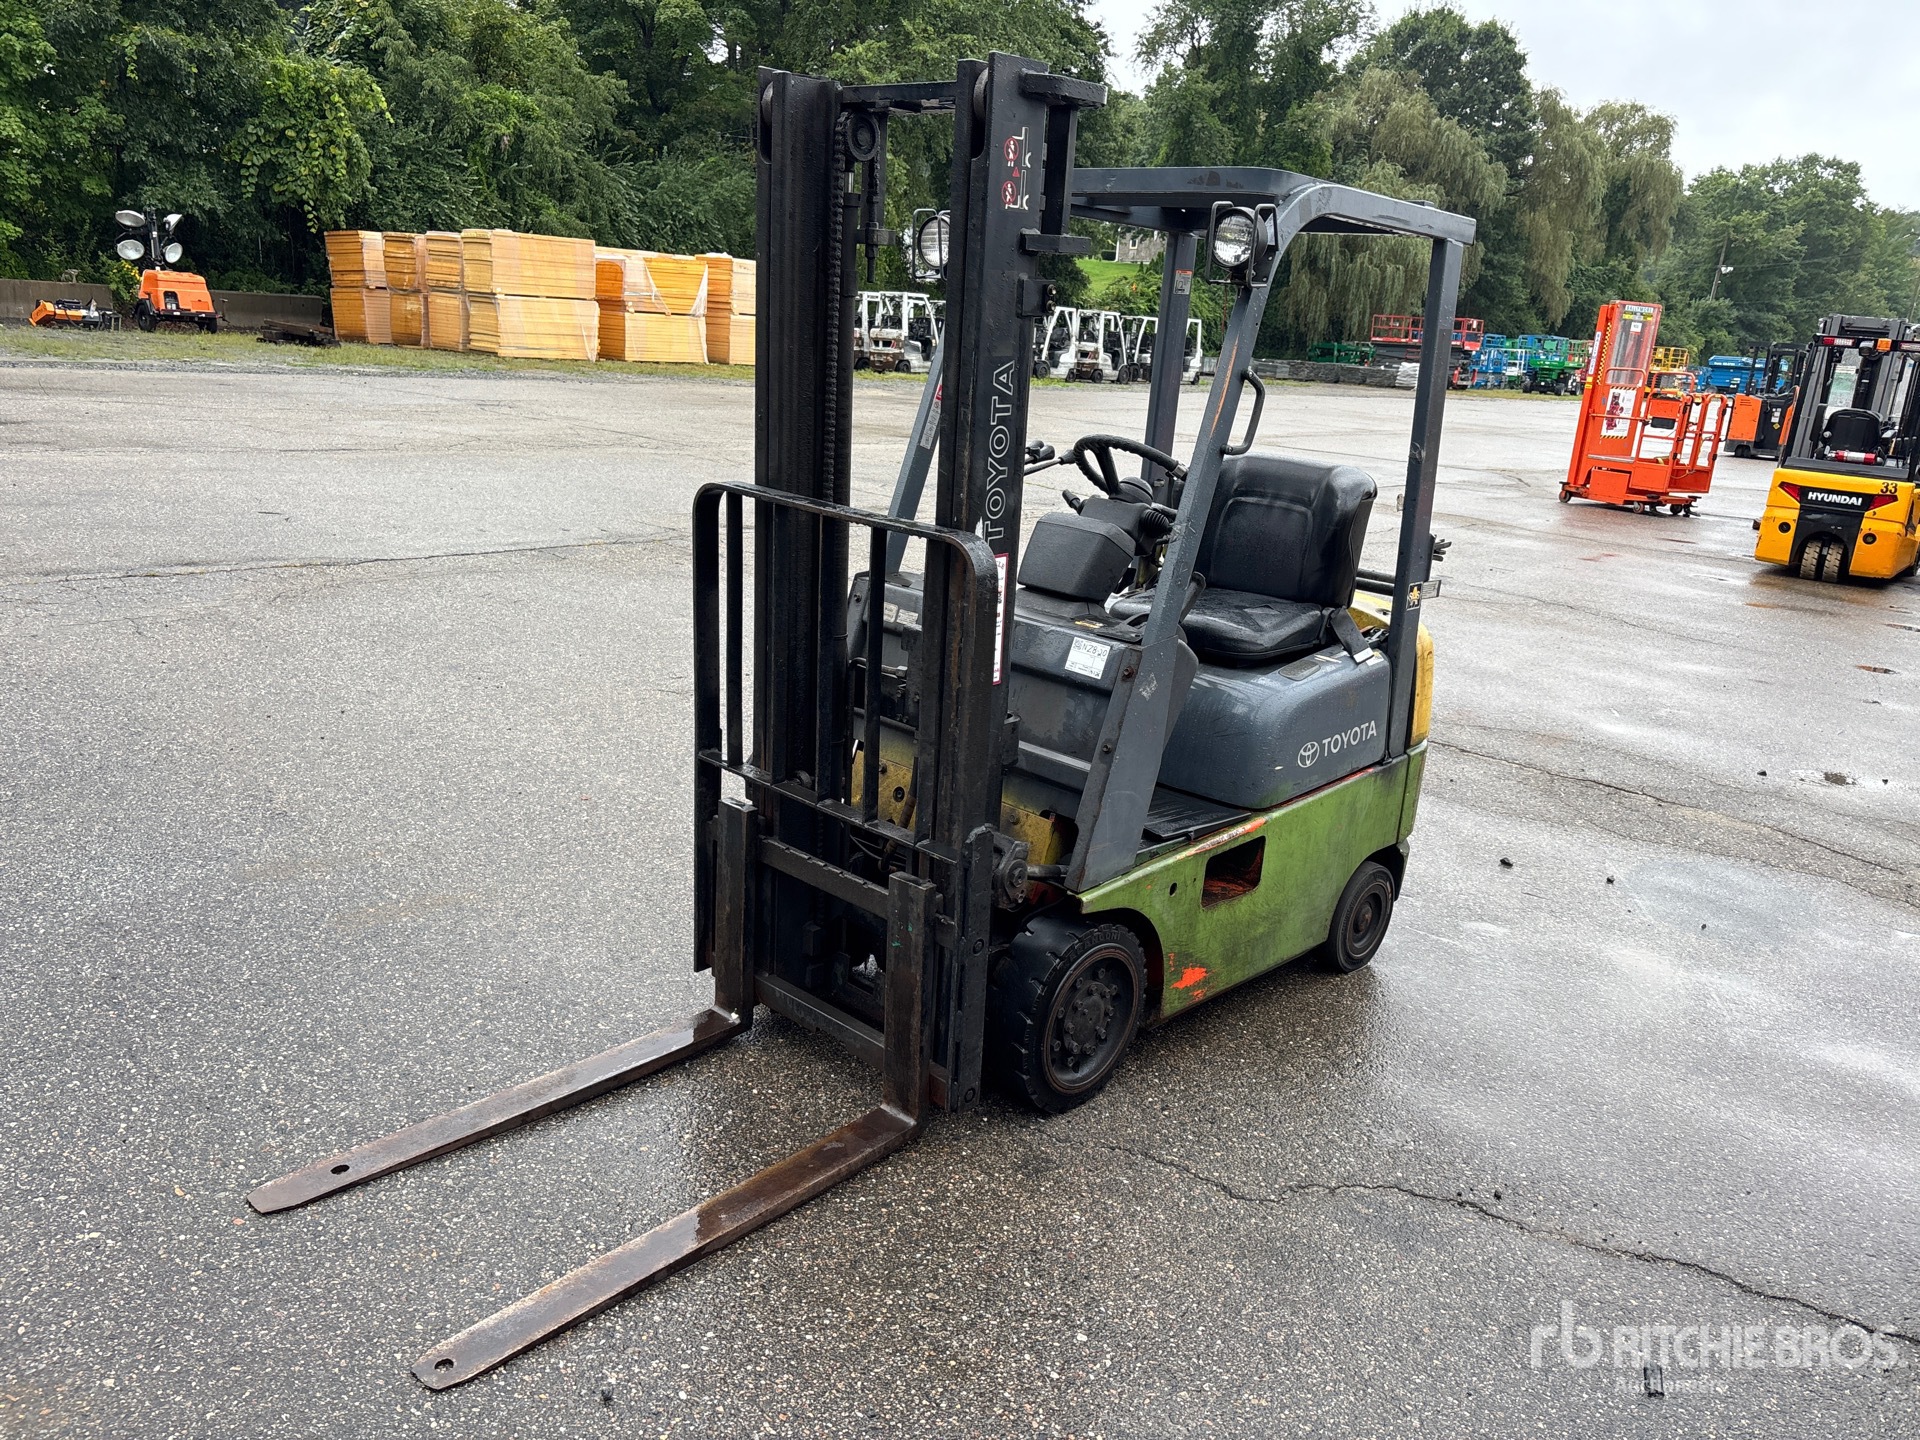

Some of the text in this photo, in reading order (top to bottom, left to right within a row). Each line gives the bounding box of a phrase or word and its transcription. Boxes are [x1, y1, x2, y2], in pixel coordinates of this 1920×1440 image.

[984, 360, 1015, 547] TOYOTA
[1807, 491, 1863, 506] HYUNDAI
[1880, 481, 1898, 494] 33
[1322, 720, 1377, 757] TOYOTA
